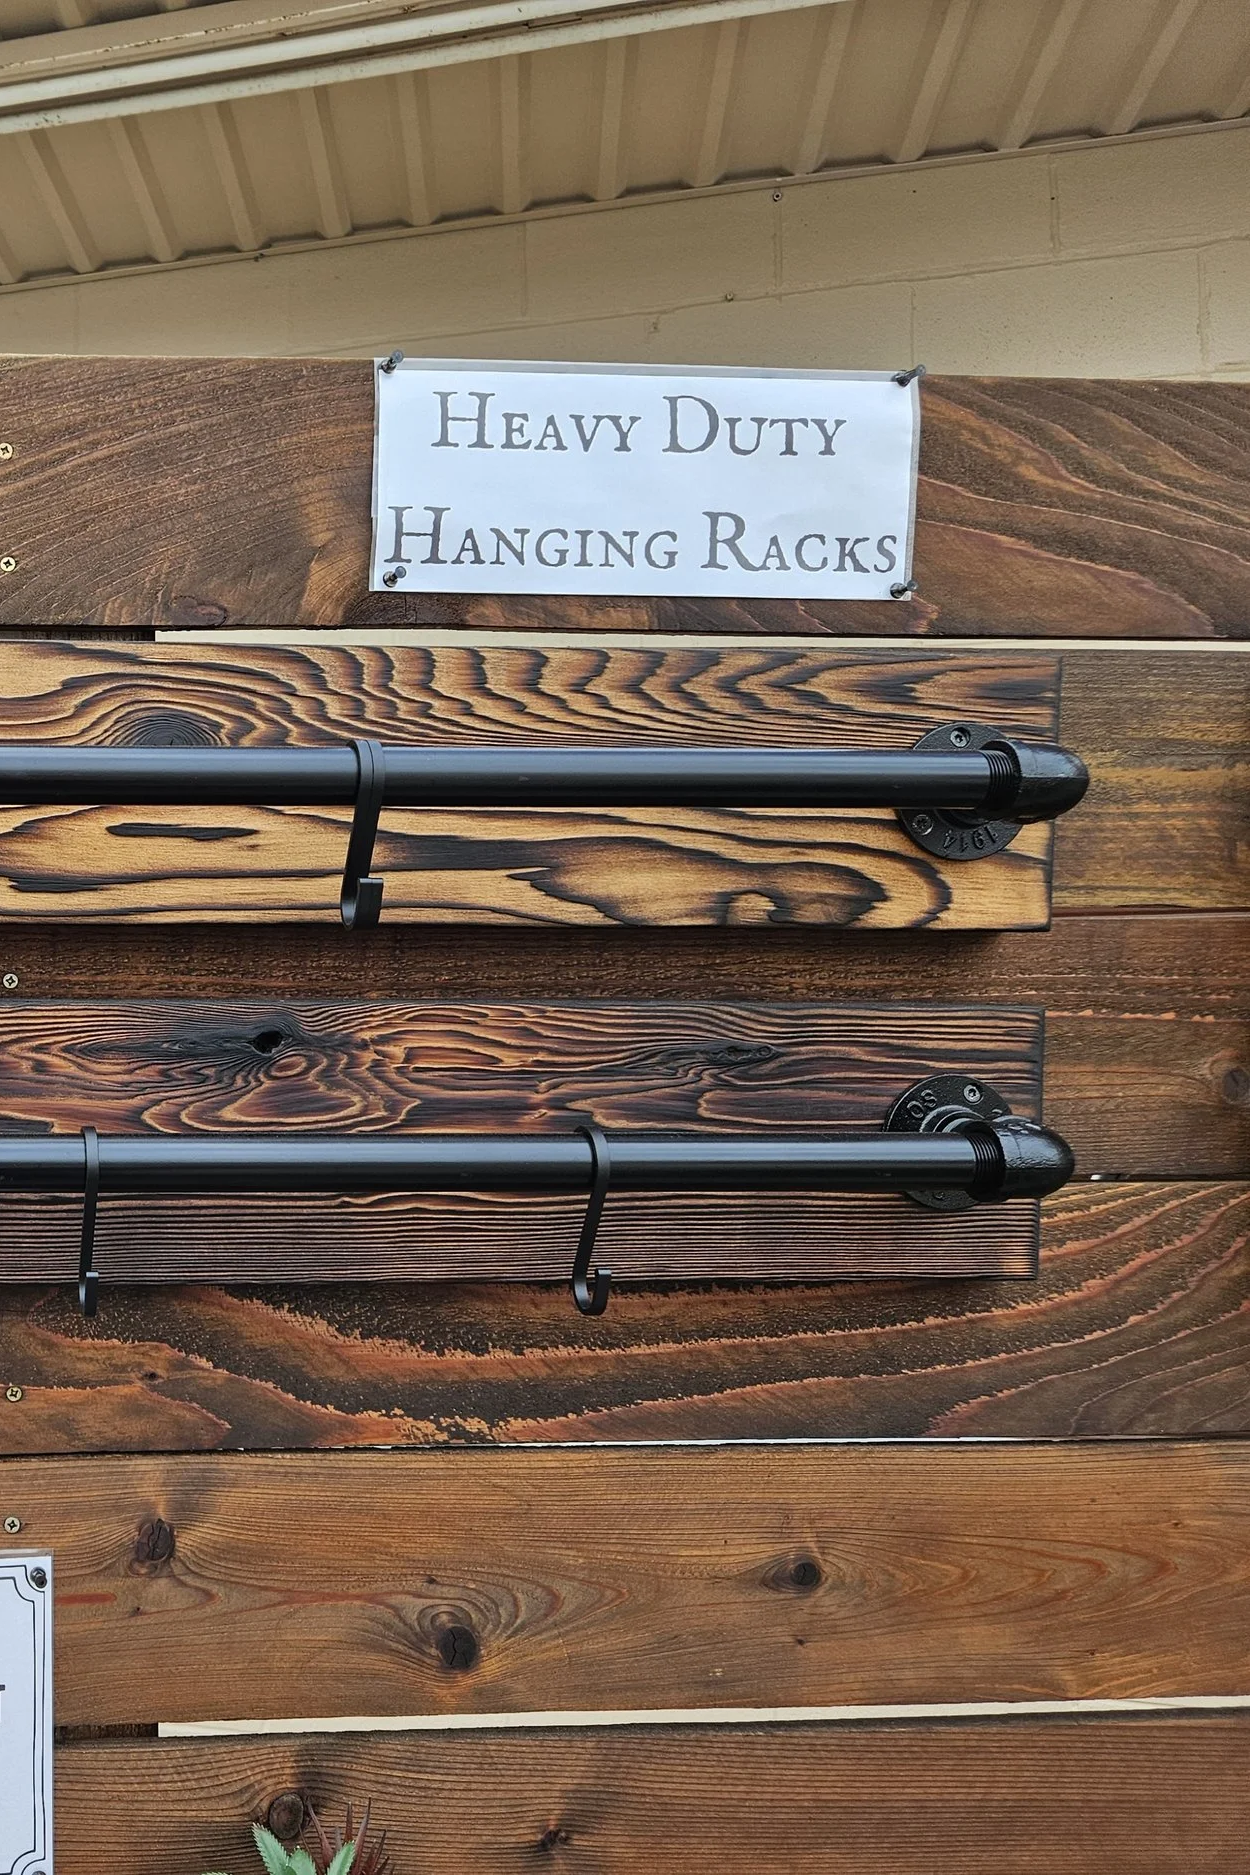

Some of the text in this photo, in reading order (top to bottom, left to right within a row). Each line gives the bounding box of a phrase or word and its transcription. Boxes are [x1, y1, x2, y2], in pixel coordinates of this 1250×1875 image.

[430, 390, 847, 457] HEAVY DUTY
[383, 505, 898, 574] HANGING RACKS
